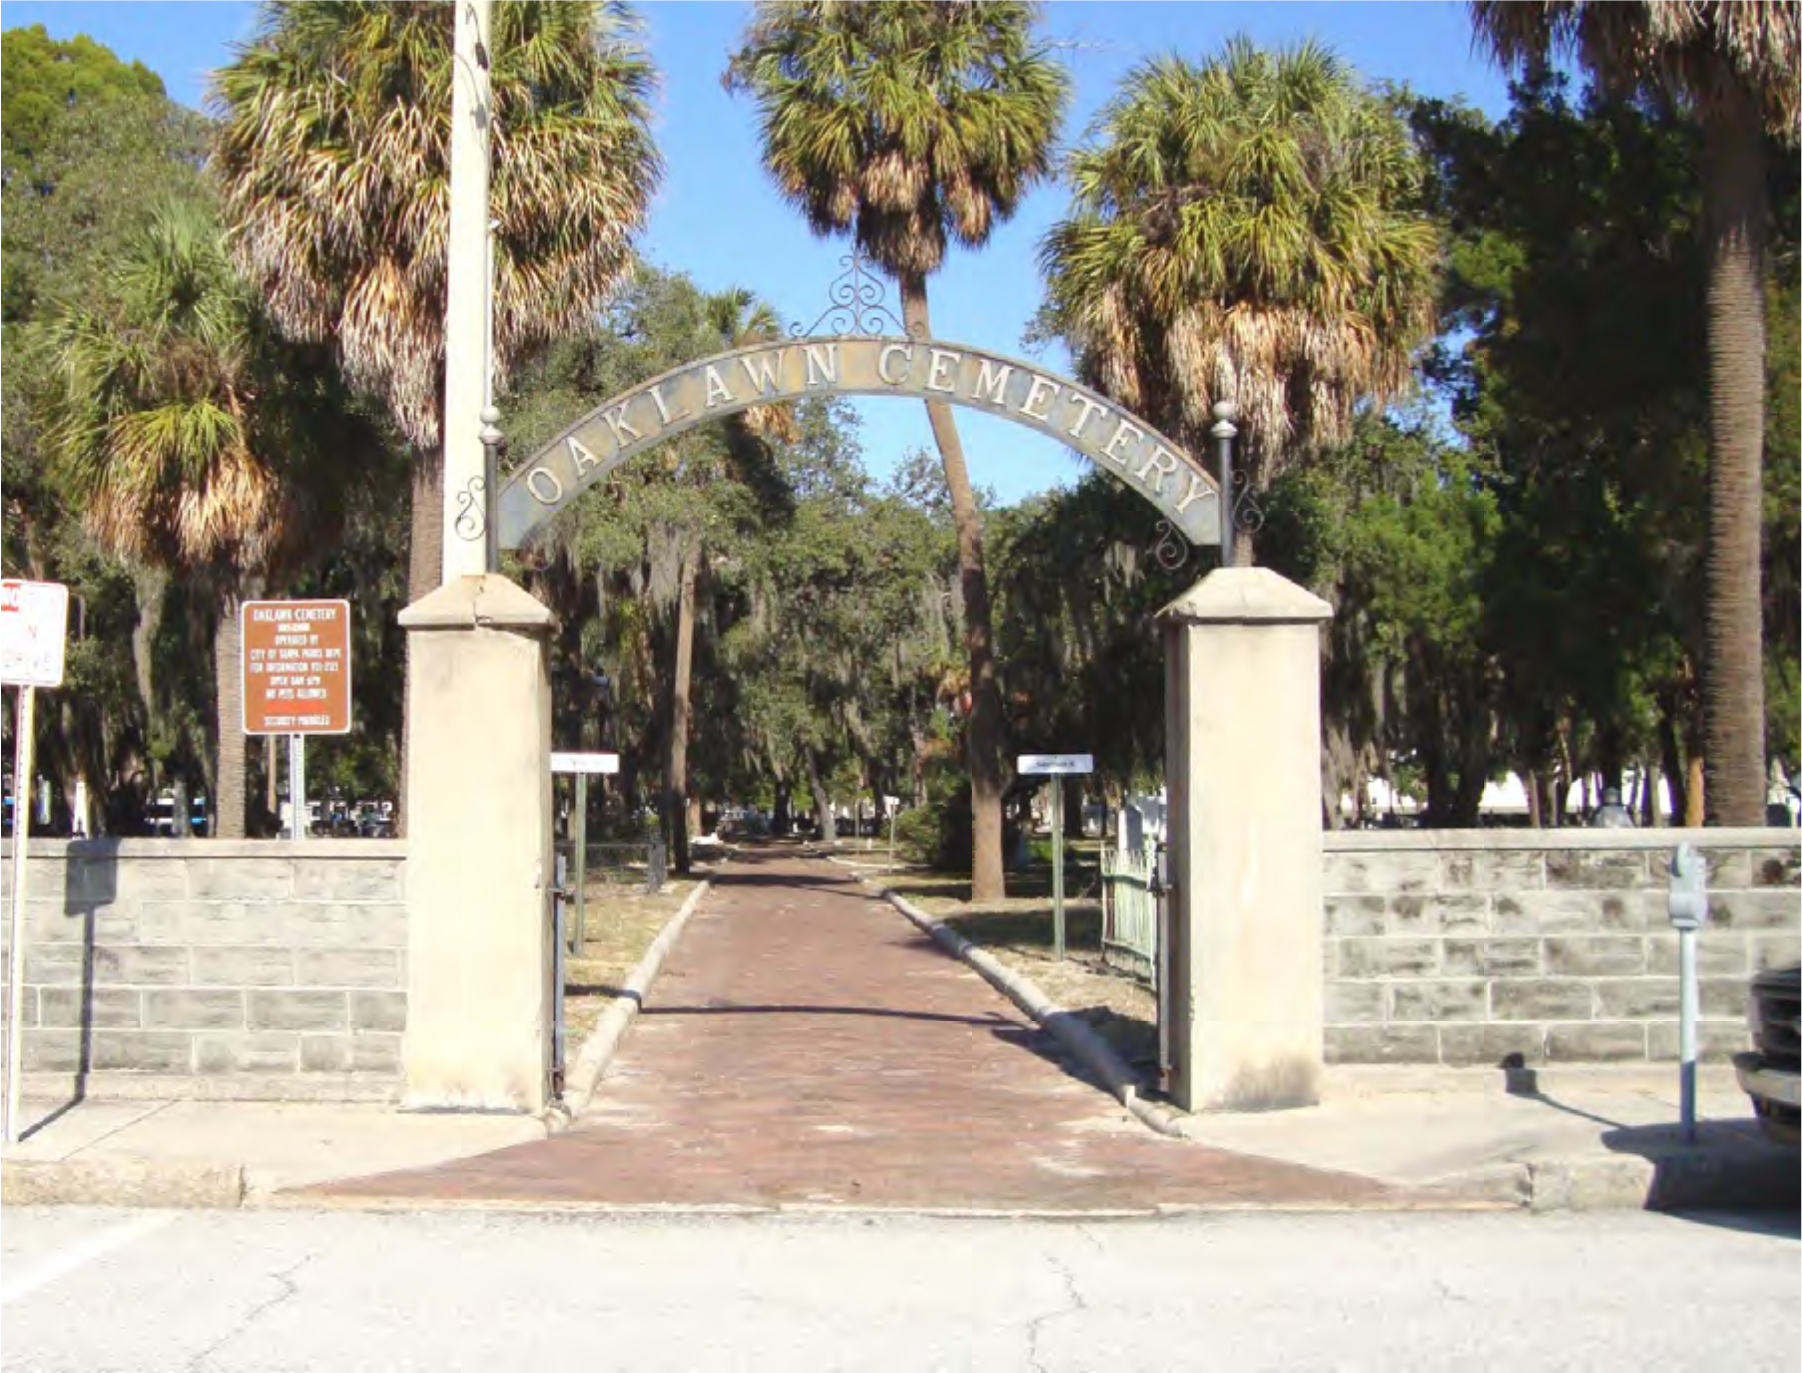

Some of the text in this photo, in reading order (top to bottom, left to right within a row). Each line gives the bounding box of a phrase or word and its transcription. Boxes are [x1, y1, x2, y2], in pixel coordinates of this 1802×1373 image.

[526, 344, 1214, 514] OAKLAWN CEMETERY
[253, 608, 336, 621] OAKLAWN CEMETERY
